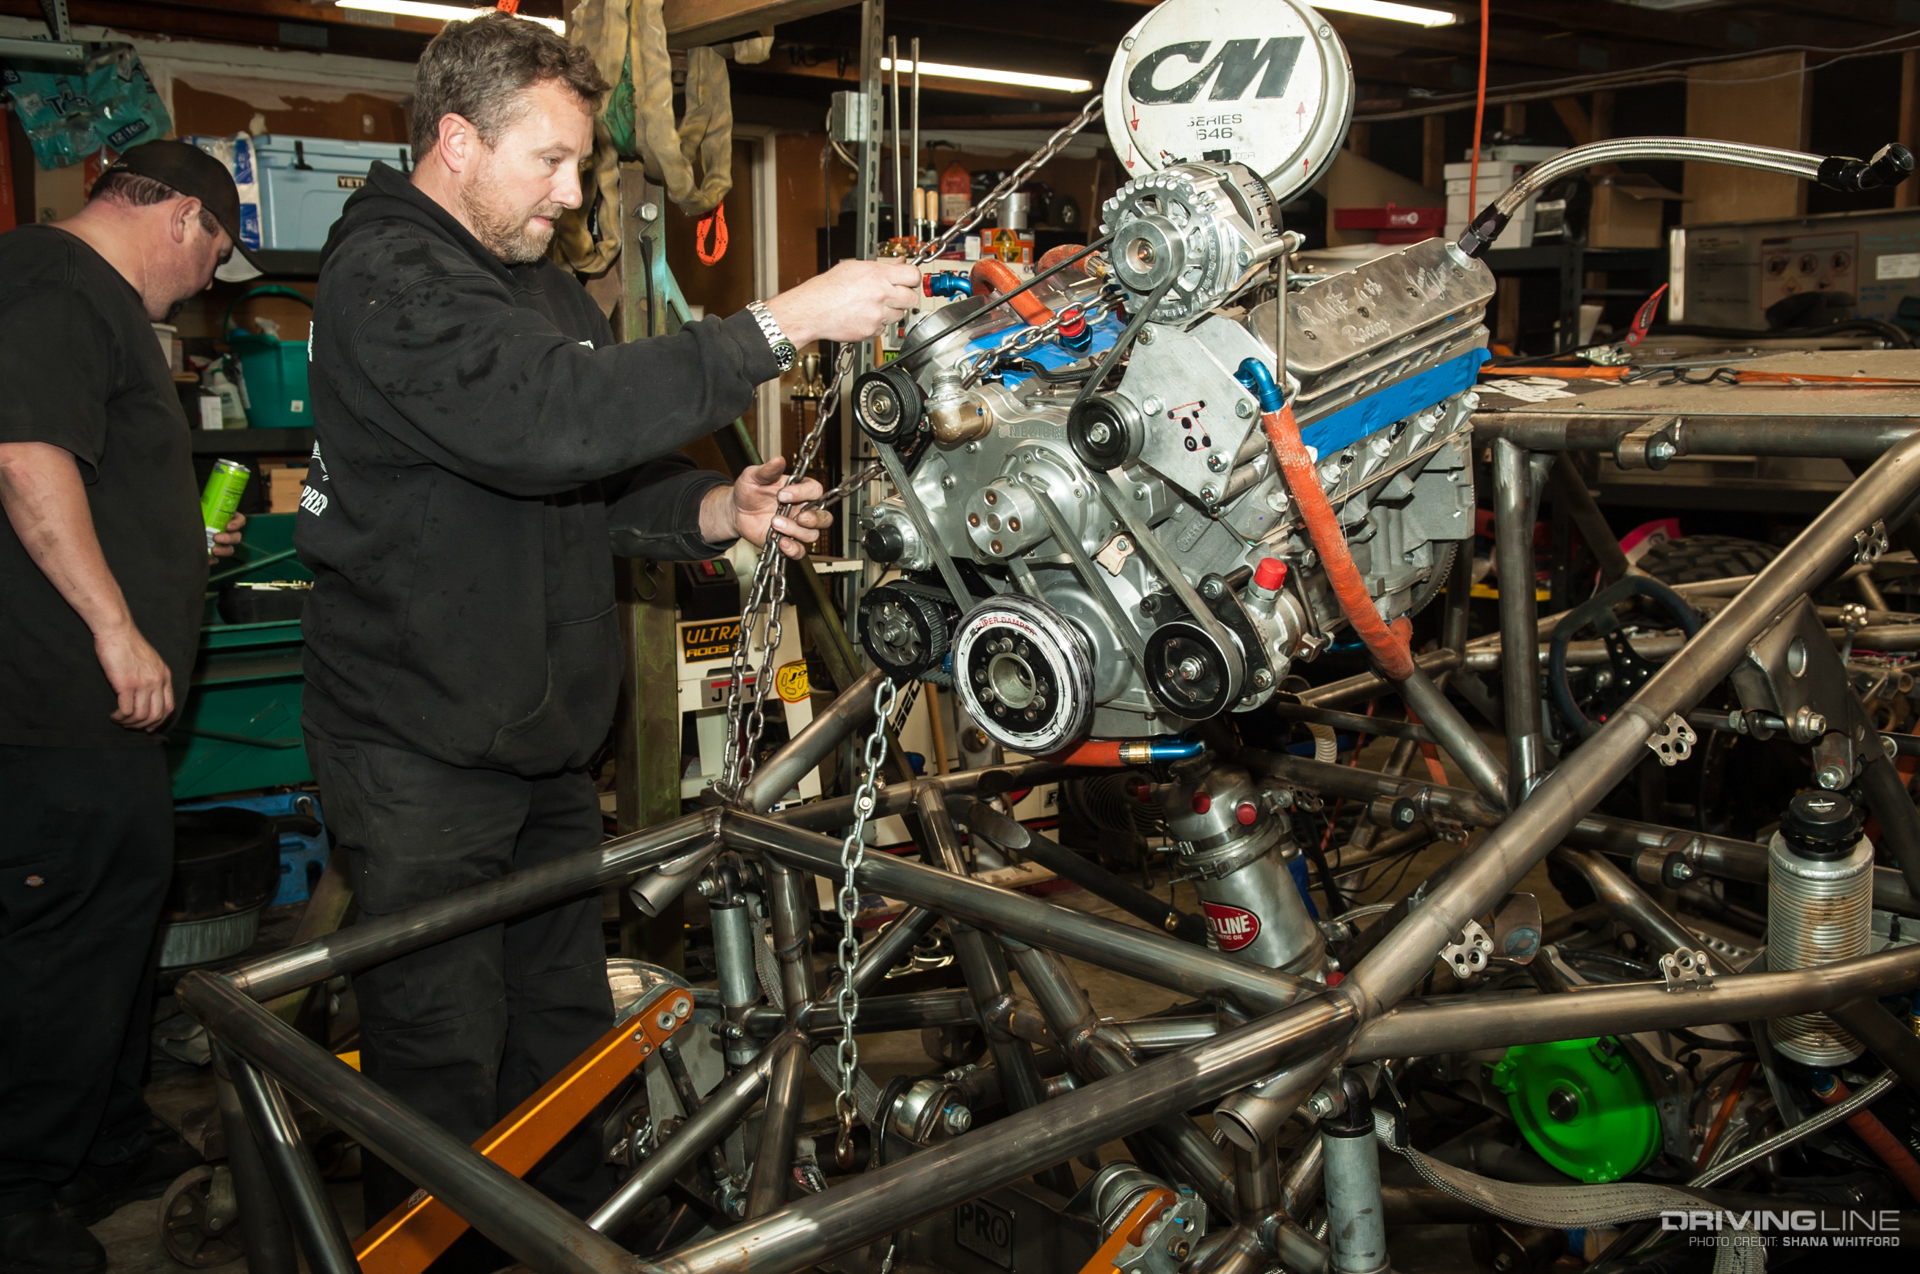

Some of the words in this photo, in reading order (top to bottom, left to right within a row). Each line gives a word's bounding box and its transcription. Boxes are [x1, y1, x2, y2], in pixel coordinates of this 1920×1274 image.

[1128, 36, 1305, 106] CM
[1187, 114, 1243, 127] SERIES
[339, 178, 365, 188] YETI
[686, 624, 741, 644] ULTRA
[1001, 616, 1038, 637] DAMPER
[686, 644, 730, 658] RODS
[711, 683, 756, 702] JT
[1217, 914, 1251, 935] LINE
[960, 1202, 1009, 1248] PRO
